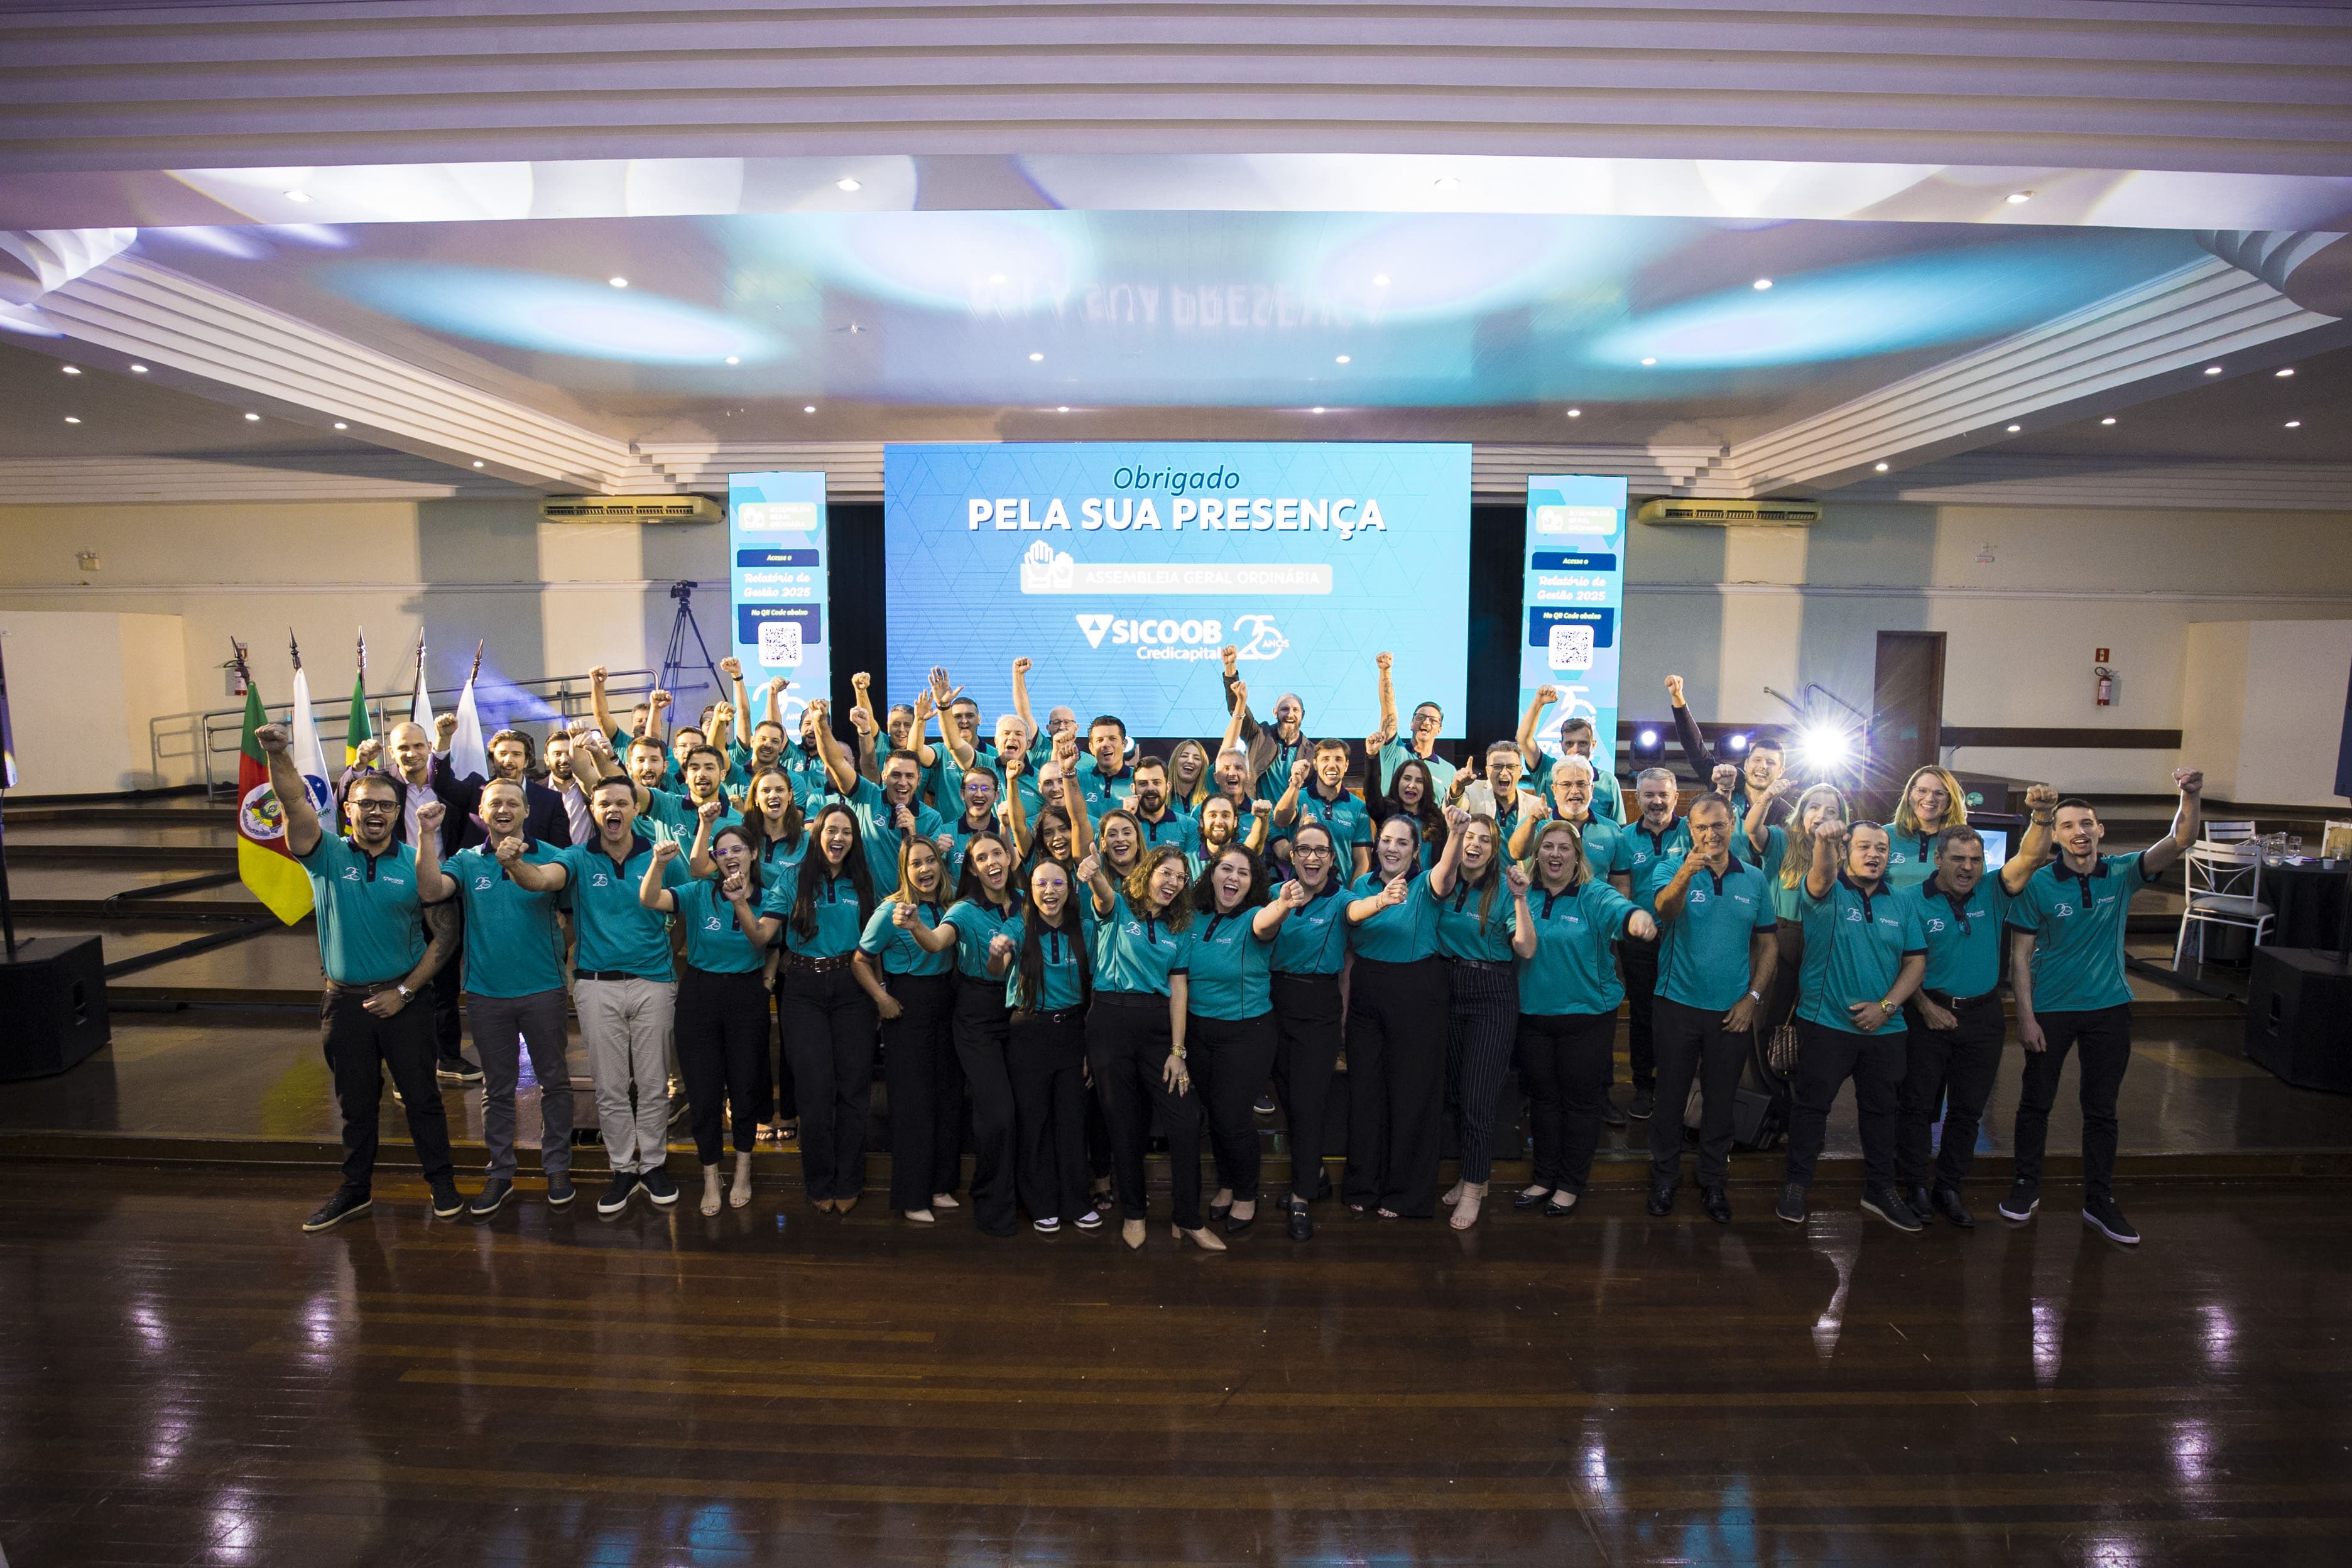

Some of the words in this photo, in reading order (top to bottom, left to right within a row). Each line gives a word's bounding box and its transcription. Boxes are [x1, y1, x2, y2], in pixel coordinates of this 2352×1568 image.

[1114, 465, 1239, 496] Obrigado
[969, 498, 1072, 531] PELA
[1081, 498, 1162, 531] SUA
[1172, 498, 1387, 540] PRESENÇA
[744, 572, 794, 584] Relatório
[796, 572, 810, 583] de
[1086, 571, 1179, 584] ASSEMBLEIA
[1184, 571, 1233, 584] GERAL
[1237, 569, 1319, 584] ORDINÁRIA
[1538, 575, 1589, 586] Relatório
[1591, 575, 1607, 587] de
[743, 587, 780, 597] Gestão
[781, 587, 811, 597] 2025
[1537, 589, 1574, 600] Gestão
[1576, 591, 1606, 601] 2025
[1111, 619, 1222, 644] SICOOB
[1233, 614, 1283, 660] 25
[1136, 646, 1222, 663] Credicapital
[1262, 638, 1290, 649] ANOS
[475, 876, 491, 890] 25
[592, 874, 607, 887] 25
[1690, 890, 1705, 903] 25
[1847, 908, 1863, 922] 25
[705, 917, 721, 931] 25
